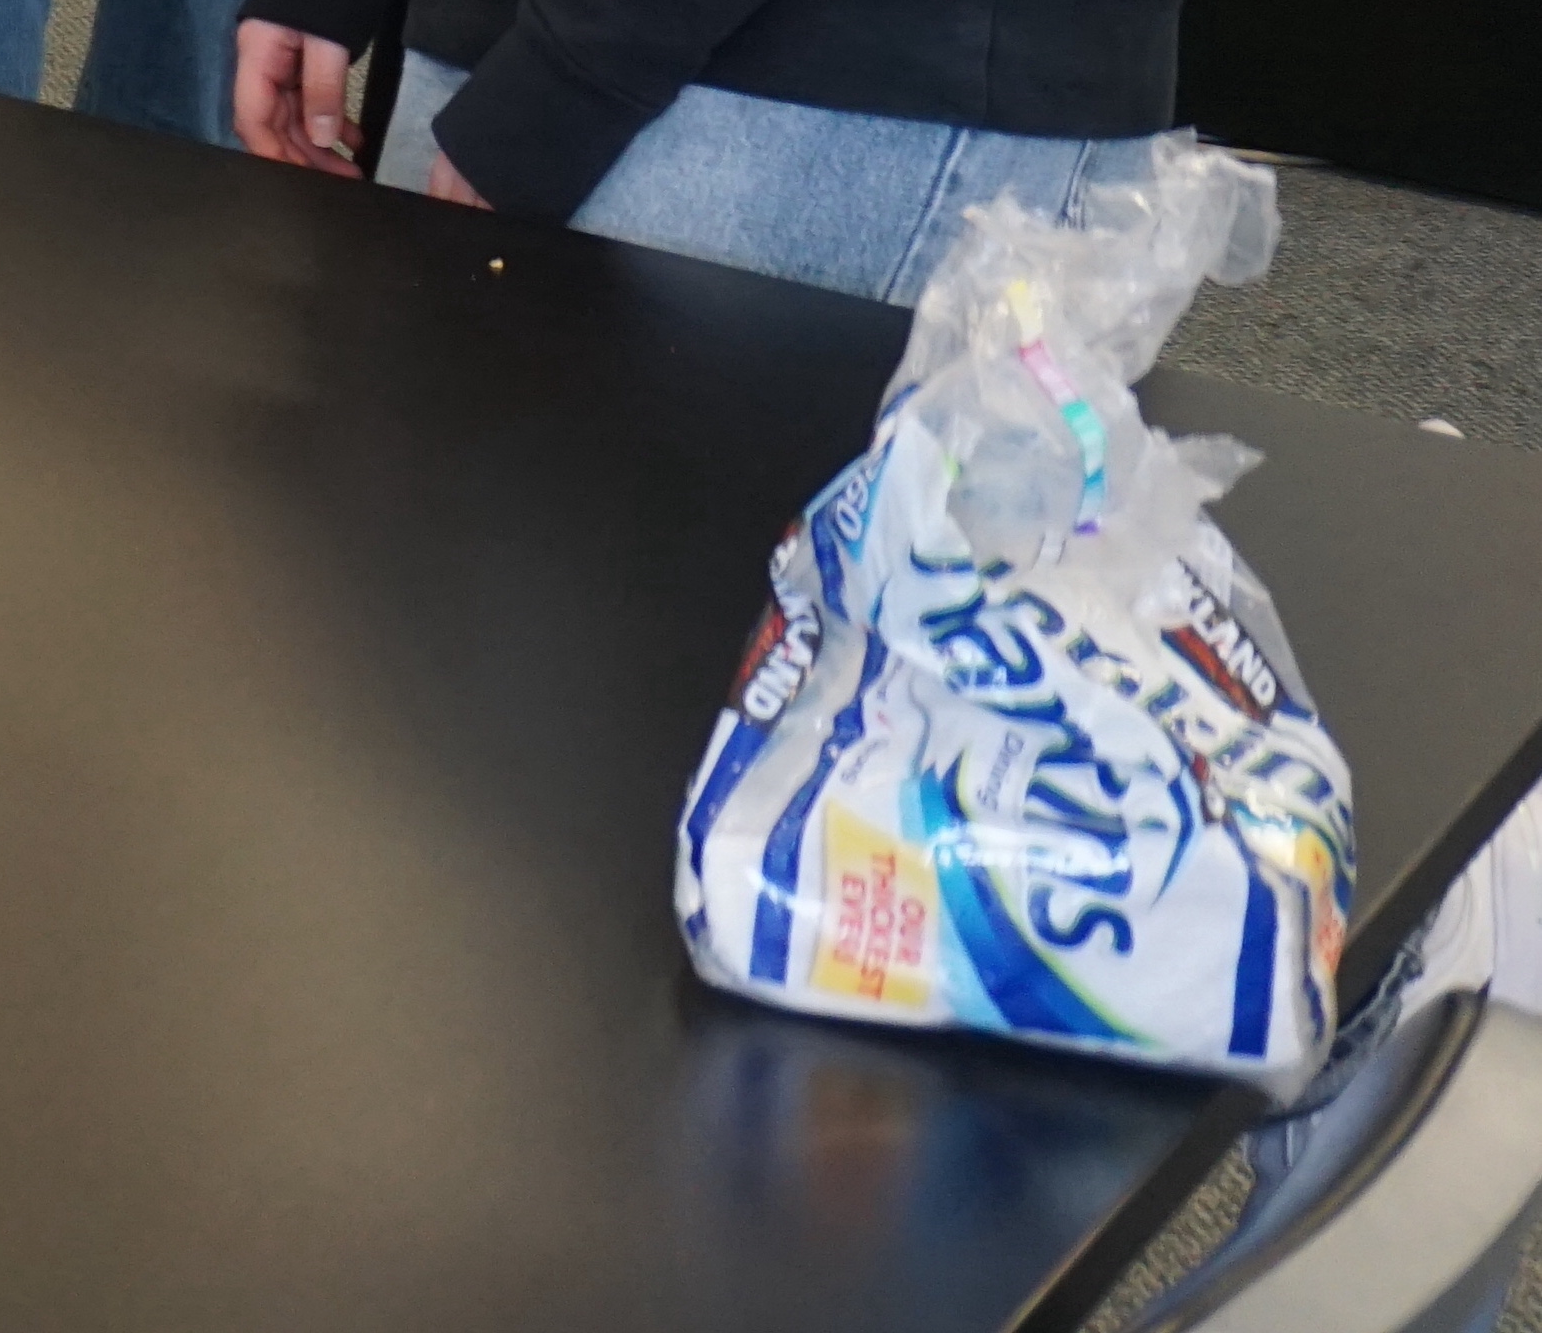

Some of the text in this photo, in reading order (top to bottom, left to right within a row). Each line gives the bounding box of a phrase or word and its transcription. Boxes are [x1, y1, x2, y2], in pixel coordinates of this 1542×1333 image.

[977, 731, 1025, 812] Dining
[858, 851, 896, 1002] THICKEST
[900, 896, 927, 967] OUR
